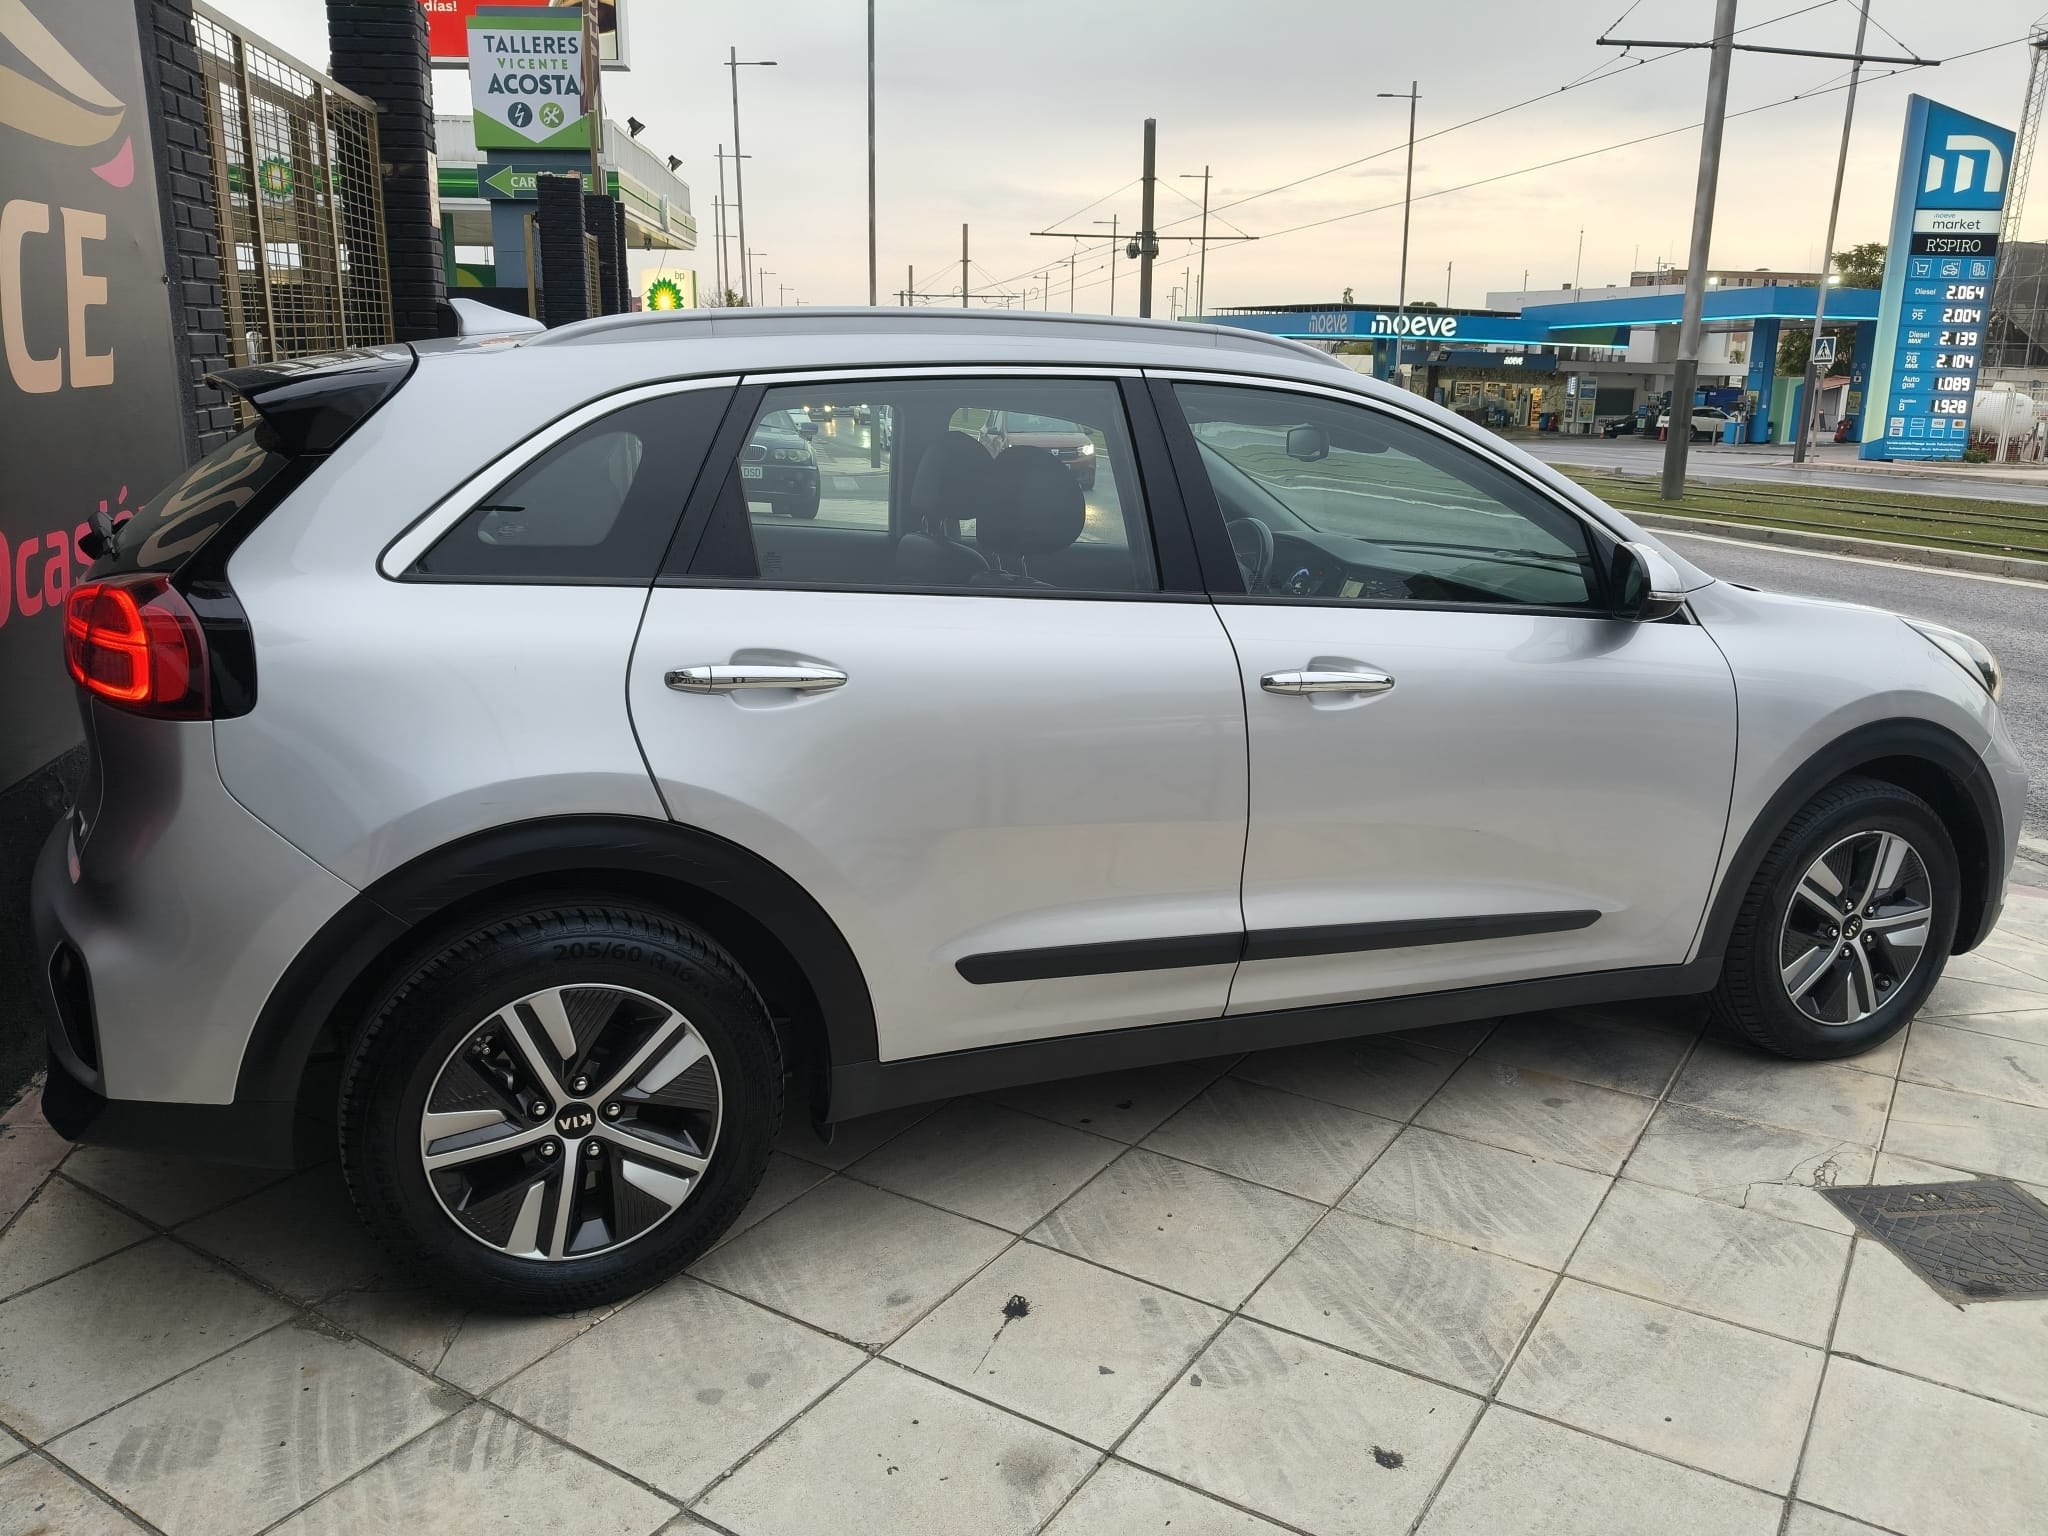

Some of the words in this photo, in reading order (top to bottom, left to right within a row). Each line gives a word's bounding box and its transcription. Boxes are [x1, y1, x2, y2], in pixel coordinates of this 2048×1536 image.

[483, 35, 579, 54] TALLERES
[497, 57, 569, 70] VICENTE
[488, 72, 582, 96] ACOSTA
[1932, 219, 1982, 230] market
[1925, 237, 1982, 253] R'SPIRO
[674, 270, 685, 282] bp
[1914, 287, 1937, 296] Diesel
[1946, 285, 1985, 300] 2.064
[1308, 313, 1348, 334] moeve
[1911, 312, 1925, 321] 95
[1942, 308, 1981, 324] 2.004
[1370, 314, 1457, 337] moeve
[1908, 331, 1930, 339] Diesel
[1939, 331, 1978, 347] 2.139
[1905, 355, 1918, 364] 98
[1936, 354, 1975, 369] 2.104
[1901, 382, 1915, 390] gas
[1937, 377, 1971, 392] 1.089
[1933, 400, 1967, 414] 1.928
[552, 941, 643, 963] 205/60
[558, 1113, 593, 1130] KIA
